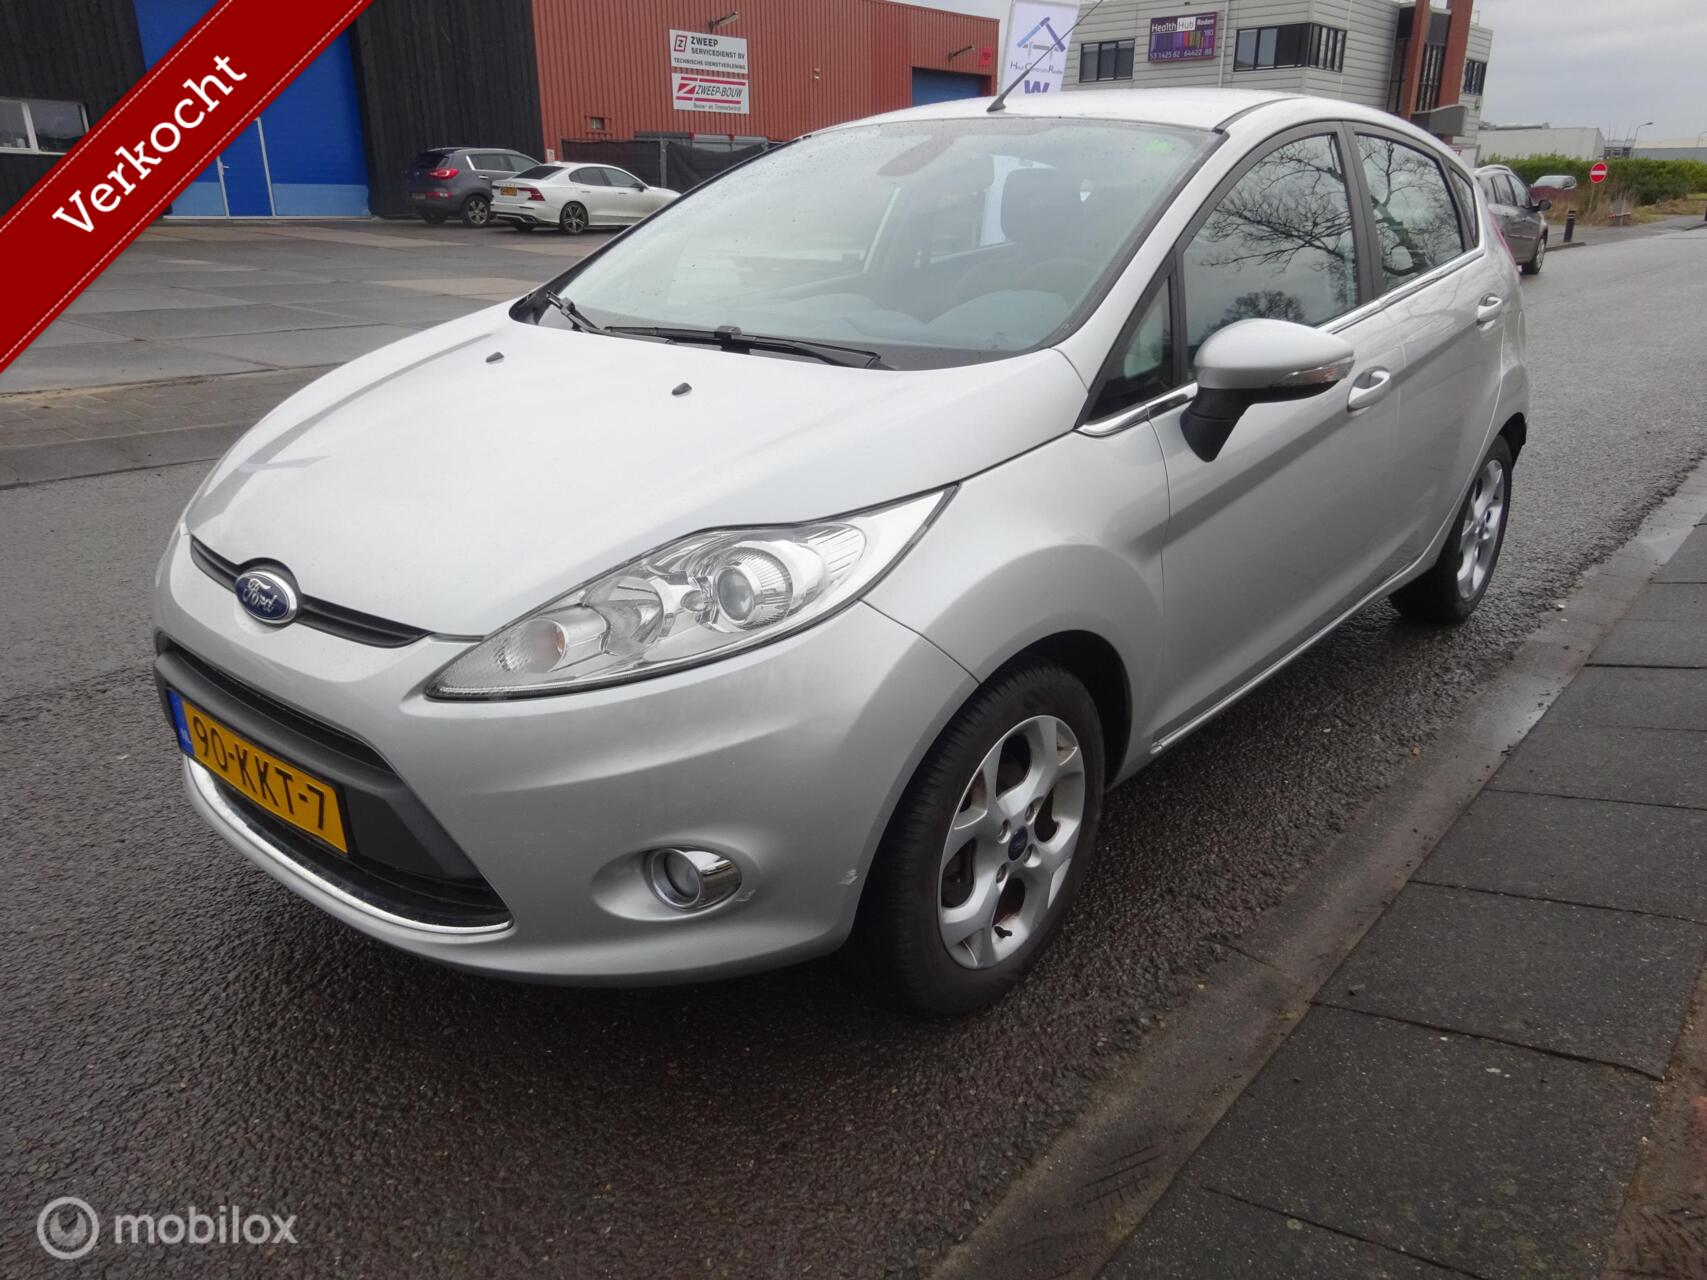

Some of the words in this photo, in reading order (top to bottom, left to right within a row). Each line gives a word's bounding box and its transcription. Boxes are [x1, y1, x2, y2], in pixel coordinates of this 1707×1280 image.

[1152, 22, 1177, 33] Health
[1178, 19, 1194, 31] Hub
[690, 36, 719, 48] ZWEEP
[691, 47, 737, 60] SERVICEDIENST
[737, 52, 746, 60] BV
[674, 57, 704, 67] TECHNISCHE
[704, 60, 746, 71] DIENSTVERLENING
[696, 84, 743, 98] ZWEEP-BOUW
[242, 578, 279, 613] Ford
[192, 715, 326, 831] 90-KKT-7
